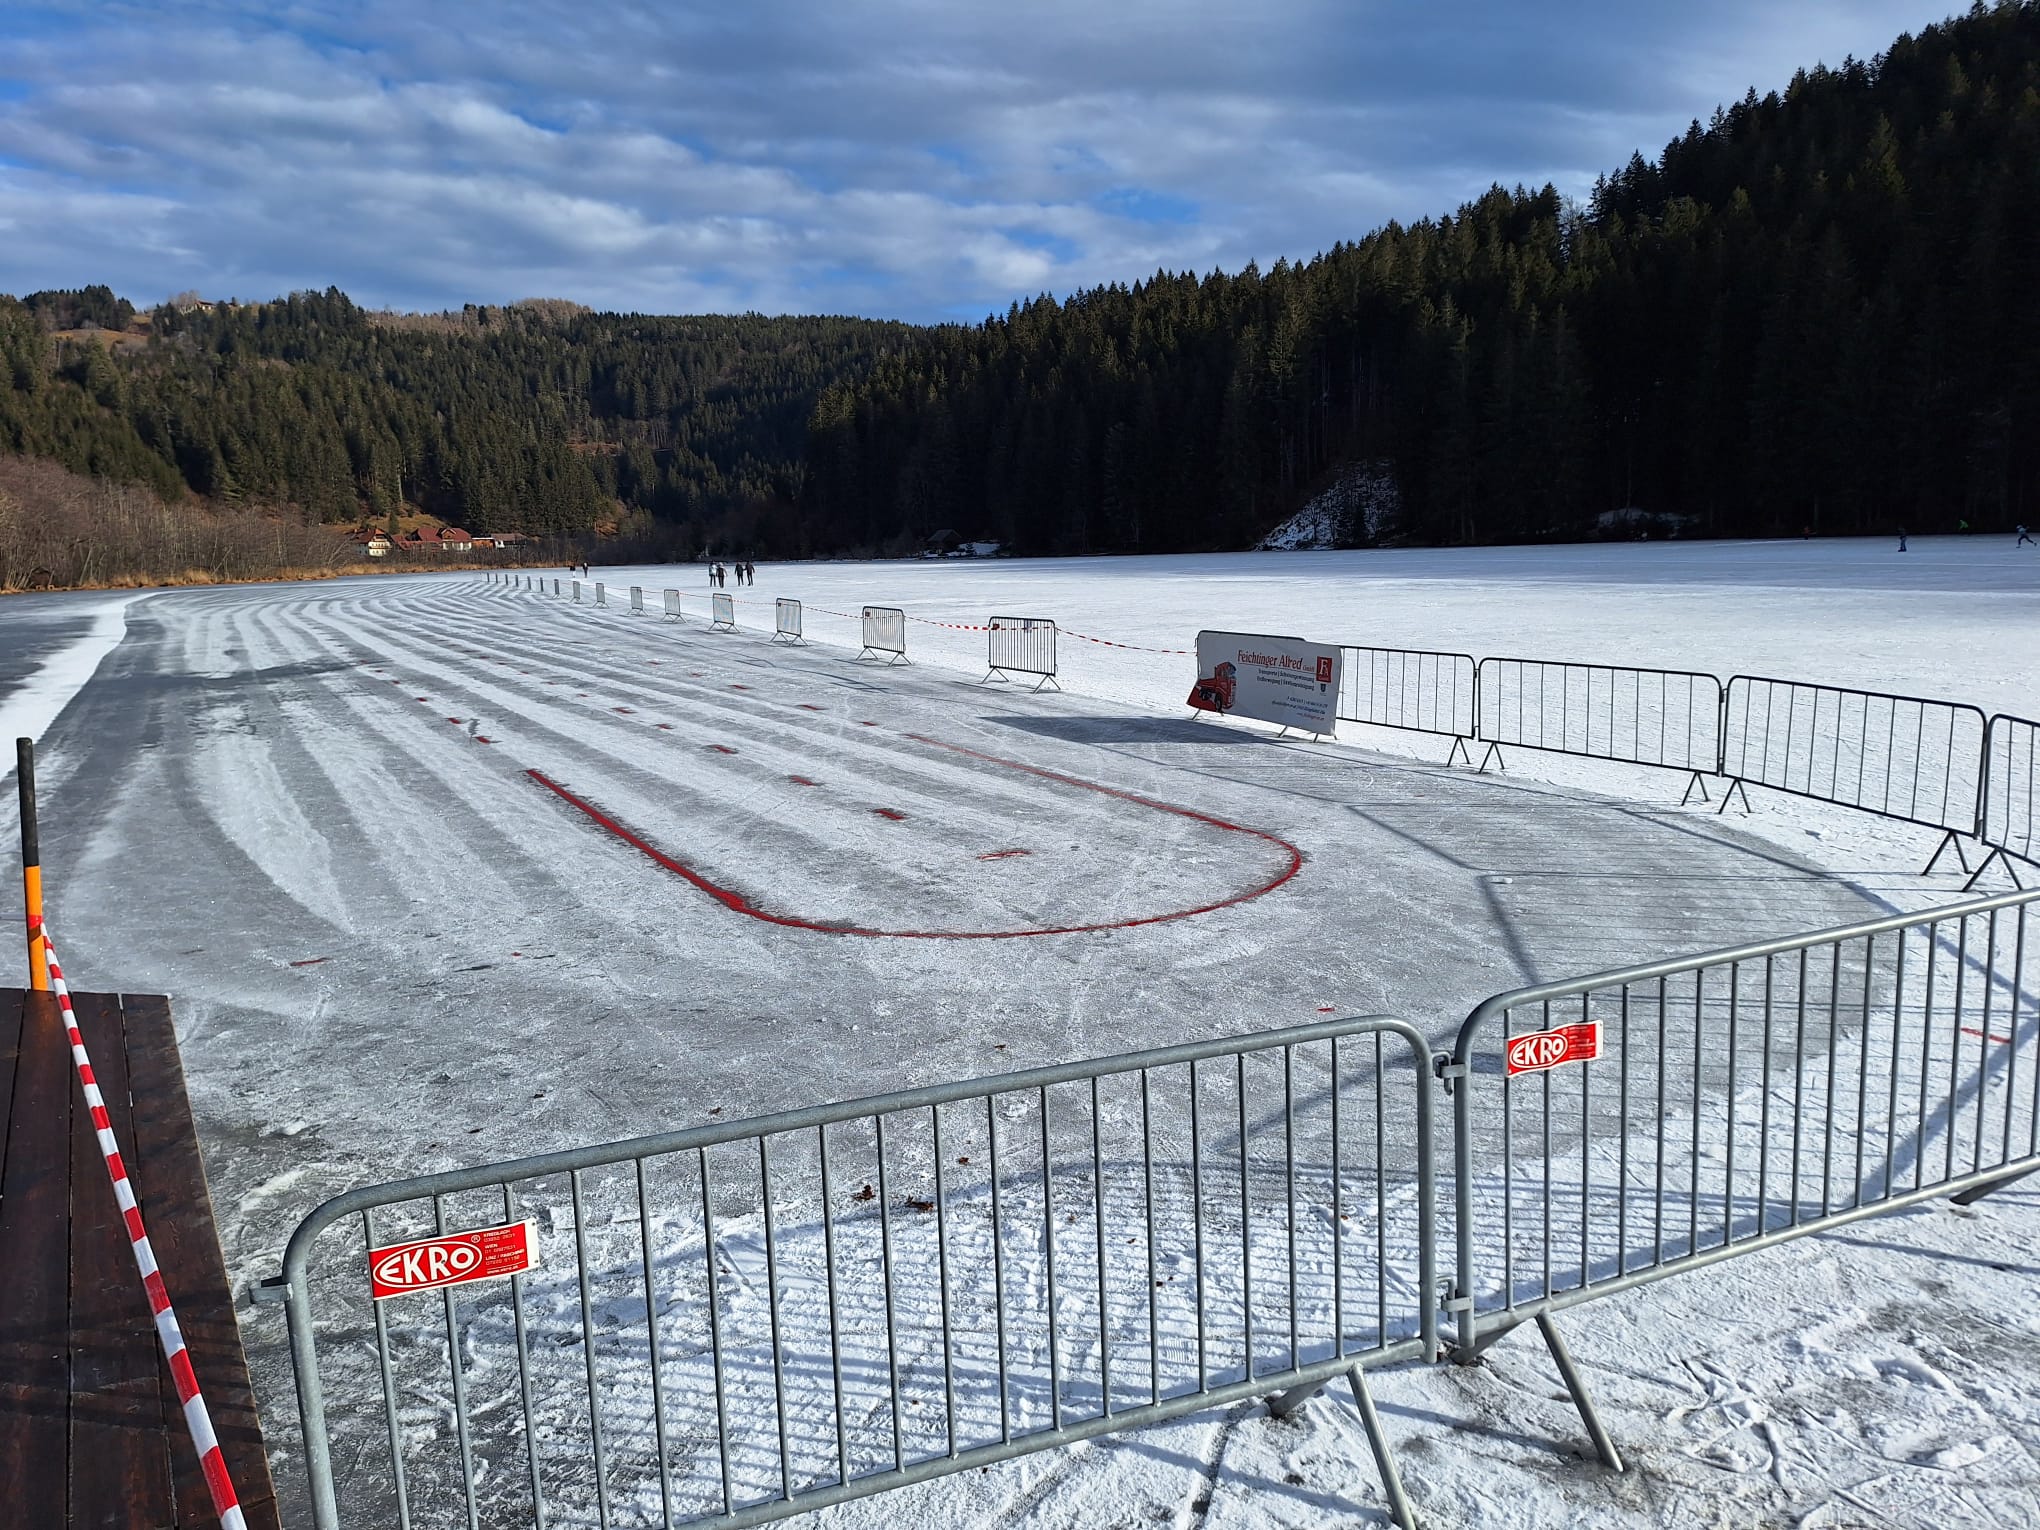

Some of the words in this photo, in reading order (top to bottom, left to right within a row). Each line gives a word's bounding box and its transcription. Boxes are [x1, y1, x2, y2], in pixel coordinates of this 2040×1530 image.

[1237, 650, 1277, 668] Feichtinger
[1279, 654, 1303, 670] Alfred
[1513, 1038, 1564, 1065] EKRO
[379, 1246, 475, 1284] EKRO
